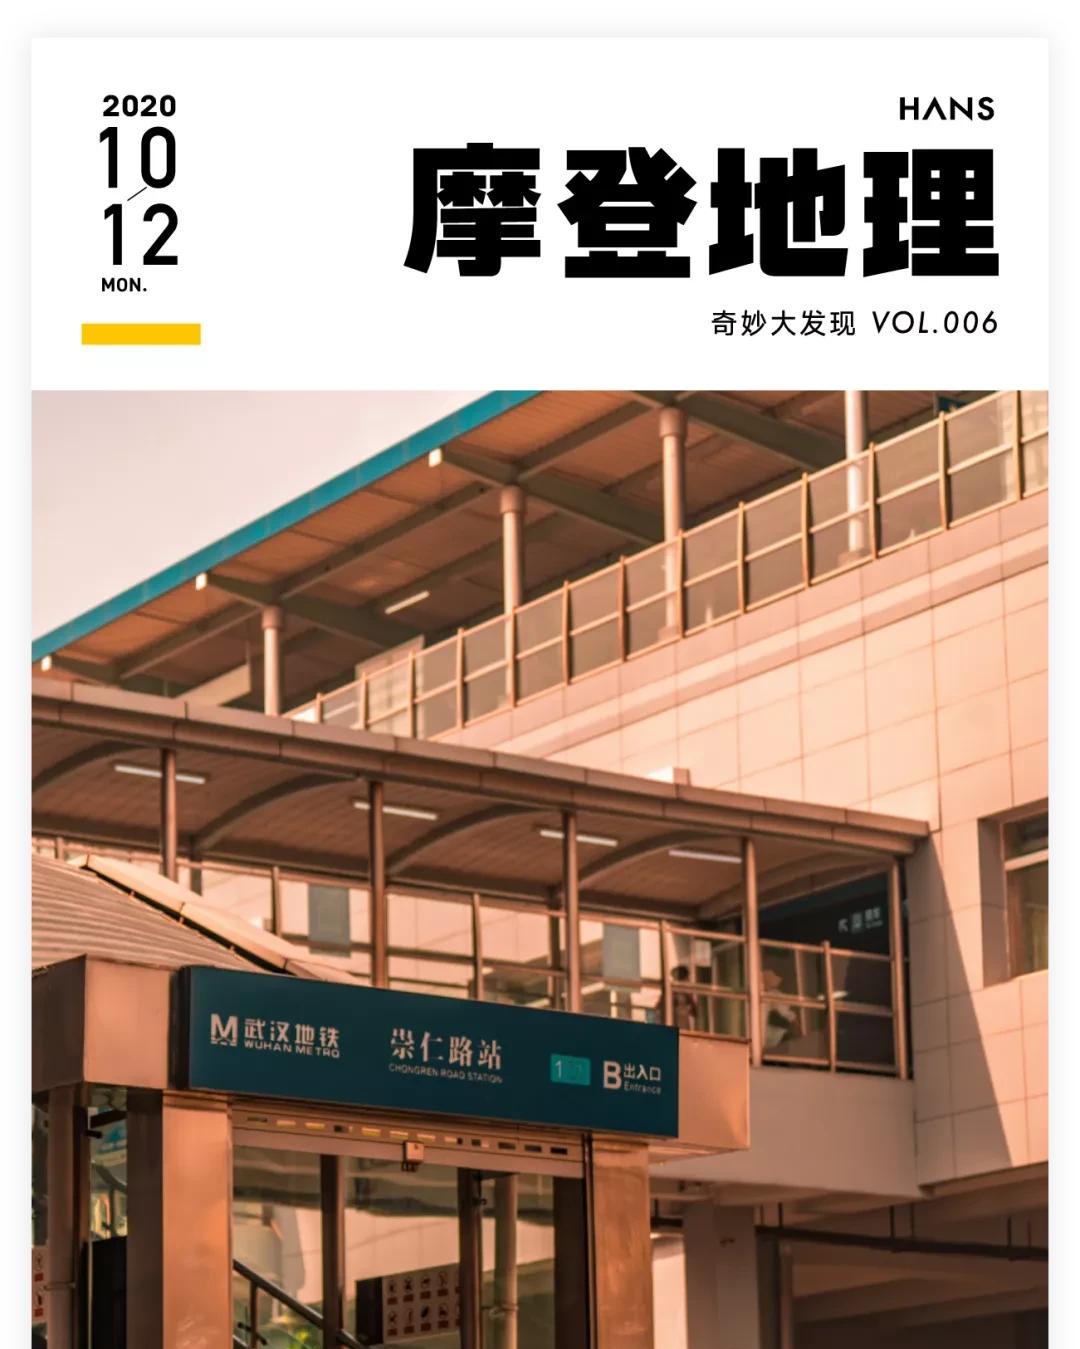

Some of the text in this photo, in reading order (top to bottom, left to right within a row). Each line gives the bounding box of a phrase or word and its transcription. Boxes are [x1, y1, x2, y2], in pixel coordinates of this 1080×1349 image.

[244, 1018, 340, 1048] 武汉地铁
[244, 1040, 340, 1058] WUHAN METRO
[389, 1027, 502, 1070] 崇仁路站
[388, 1063, 503, 1084] CHONGREN ROAD STATION
[603, 1060, 622, 1090] B
[623, 1062, 661, 1082] 出入口
